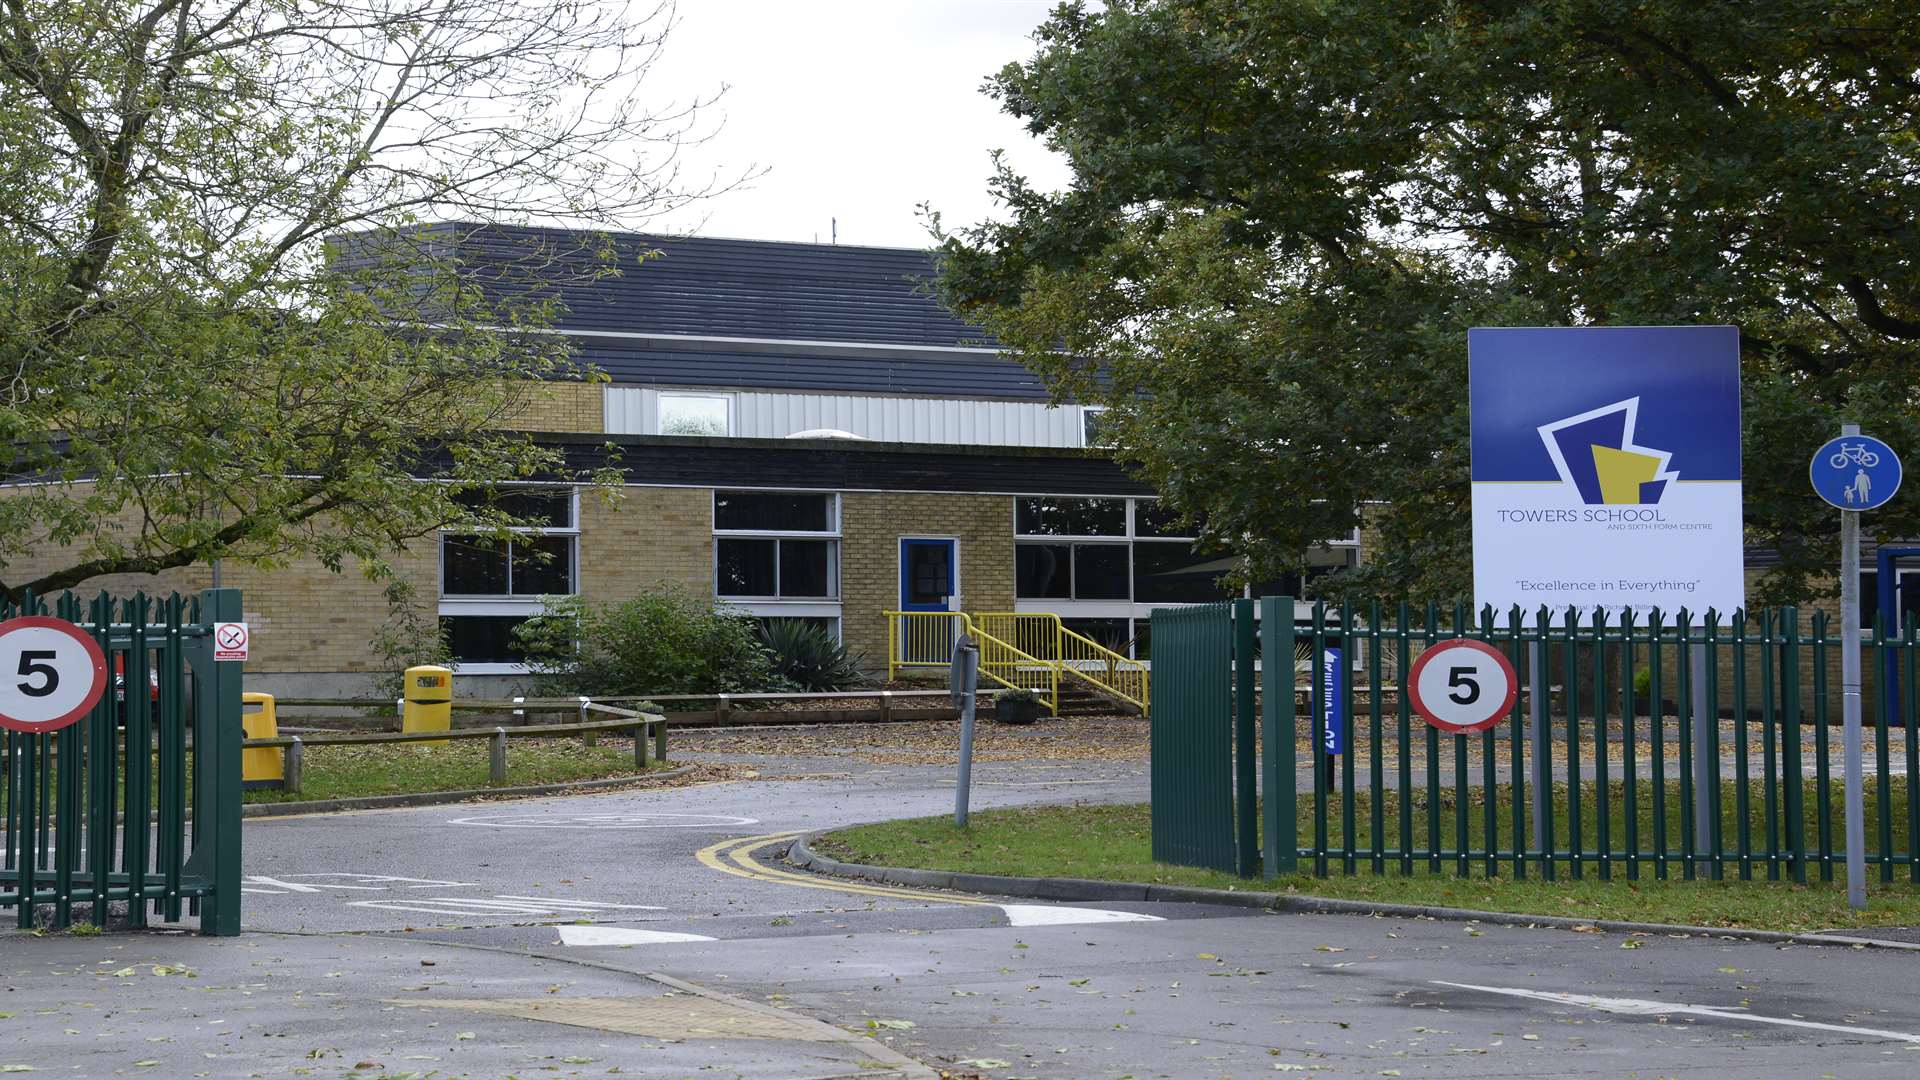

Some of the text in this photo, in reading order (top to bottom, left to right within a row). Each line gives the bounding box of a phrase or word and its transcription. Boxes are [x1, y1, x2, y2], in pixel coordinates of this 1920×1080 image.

[1497, 509, 1666, 522] TOWERS SCHOOL
[1601, 580, 1614, 591] in
[17, 650, 59, 697] 5
[1448, 666, 1480, 705] 5
